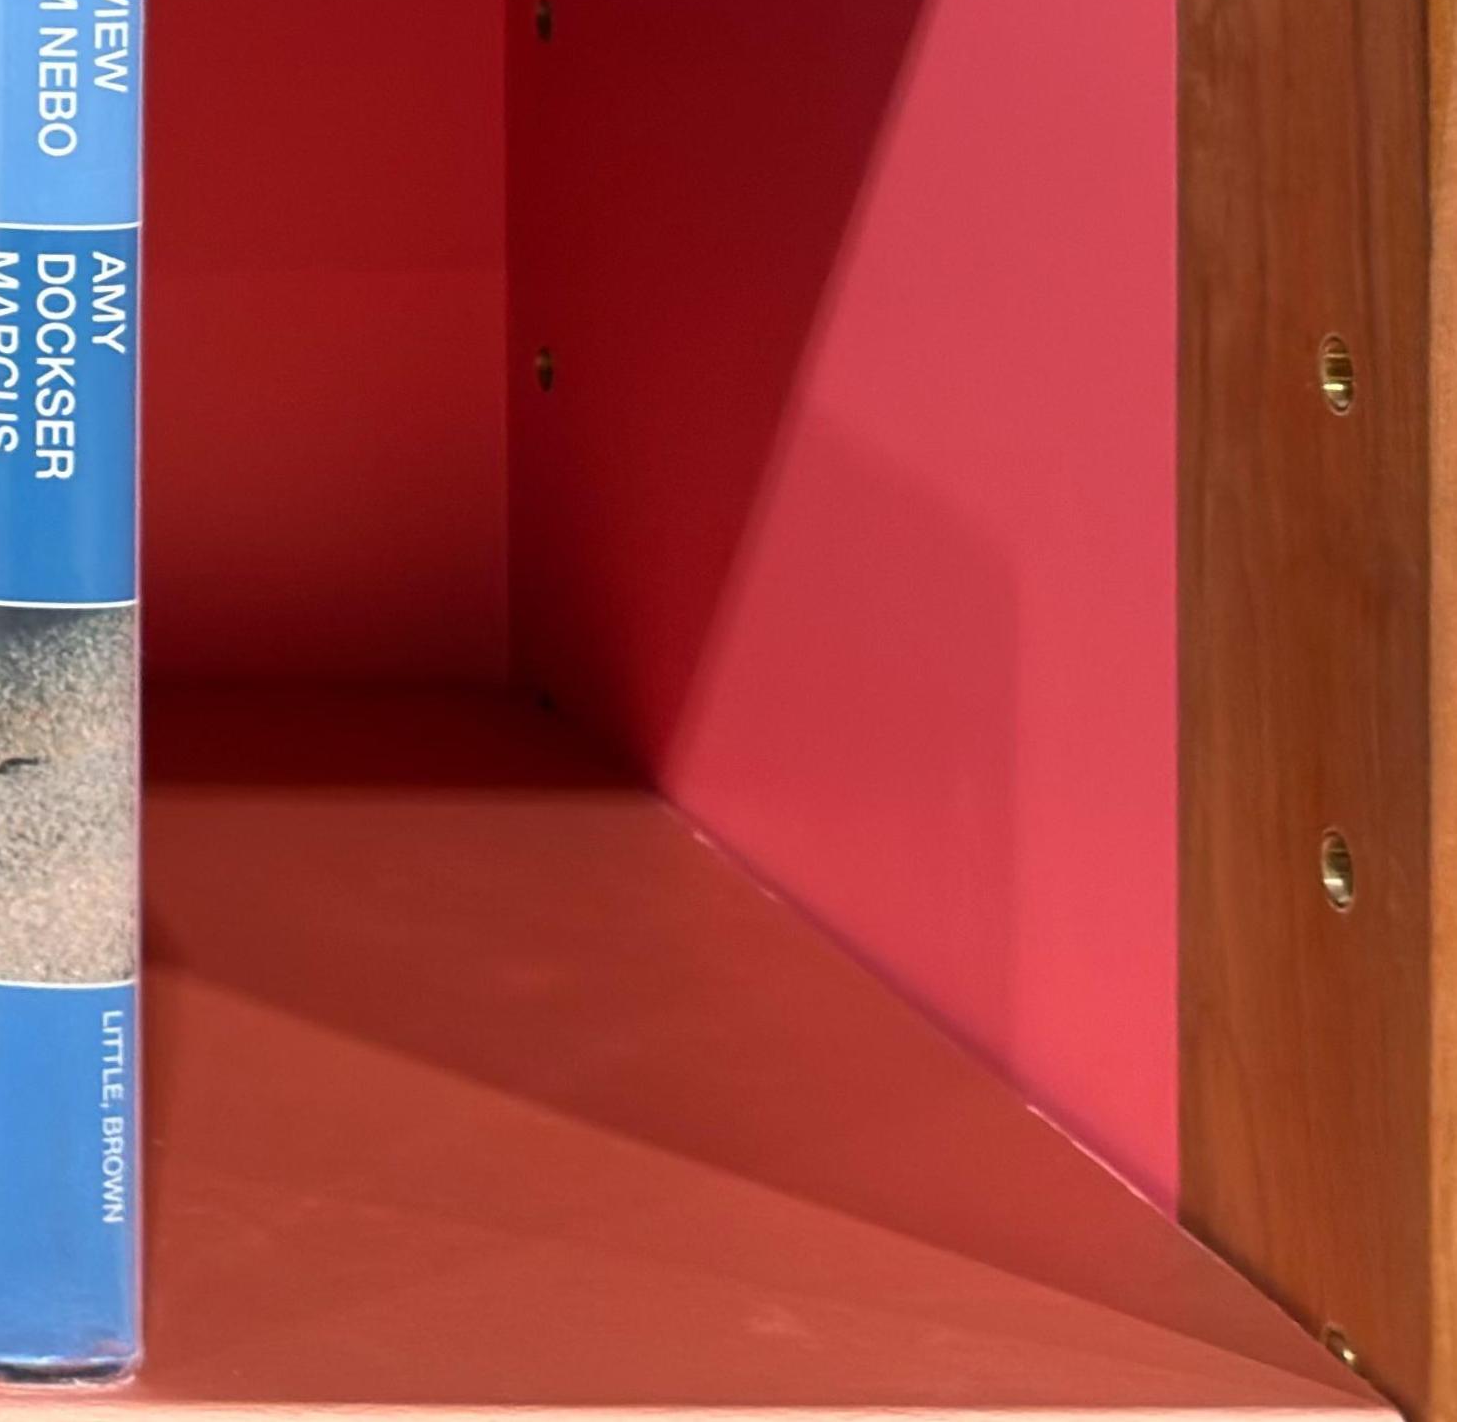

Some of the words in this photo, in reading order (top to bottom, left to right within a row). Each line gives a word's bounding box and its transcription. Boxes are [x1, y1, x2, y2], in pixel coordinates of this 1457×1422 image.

[36, 27, 79, 158] NEBO
[91, 250, 127, 355] AMY
[35, 252, 77, 481] DOCKSER
[99, 1009, 125, 1109] LITTLE,
[99, 1115, 125, 1225] BROWN
